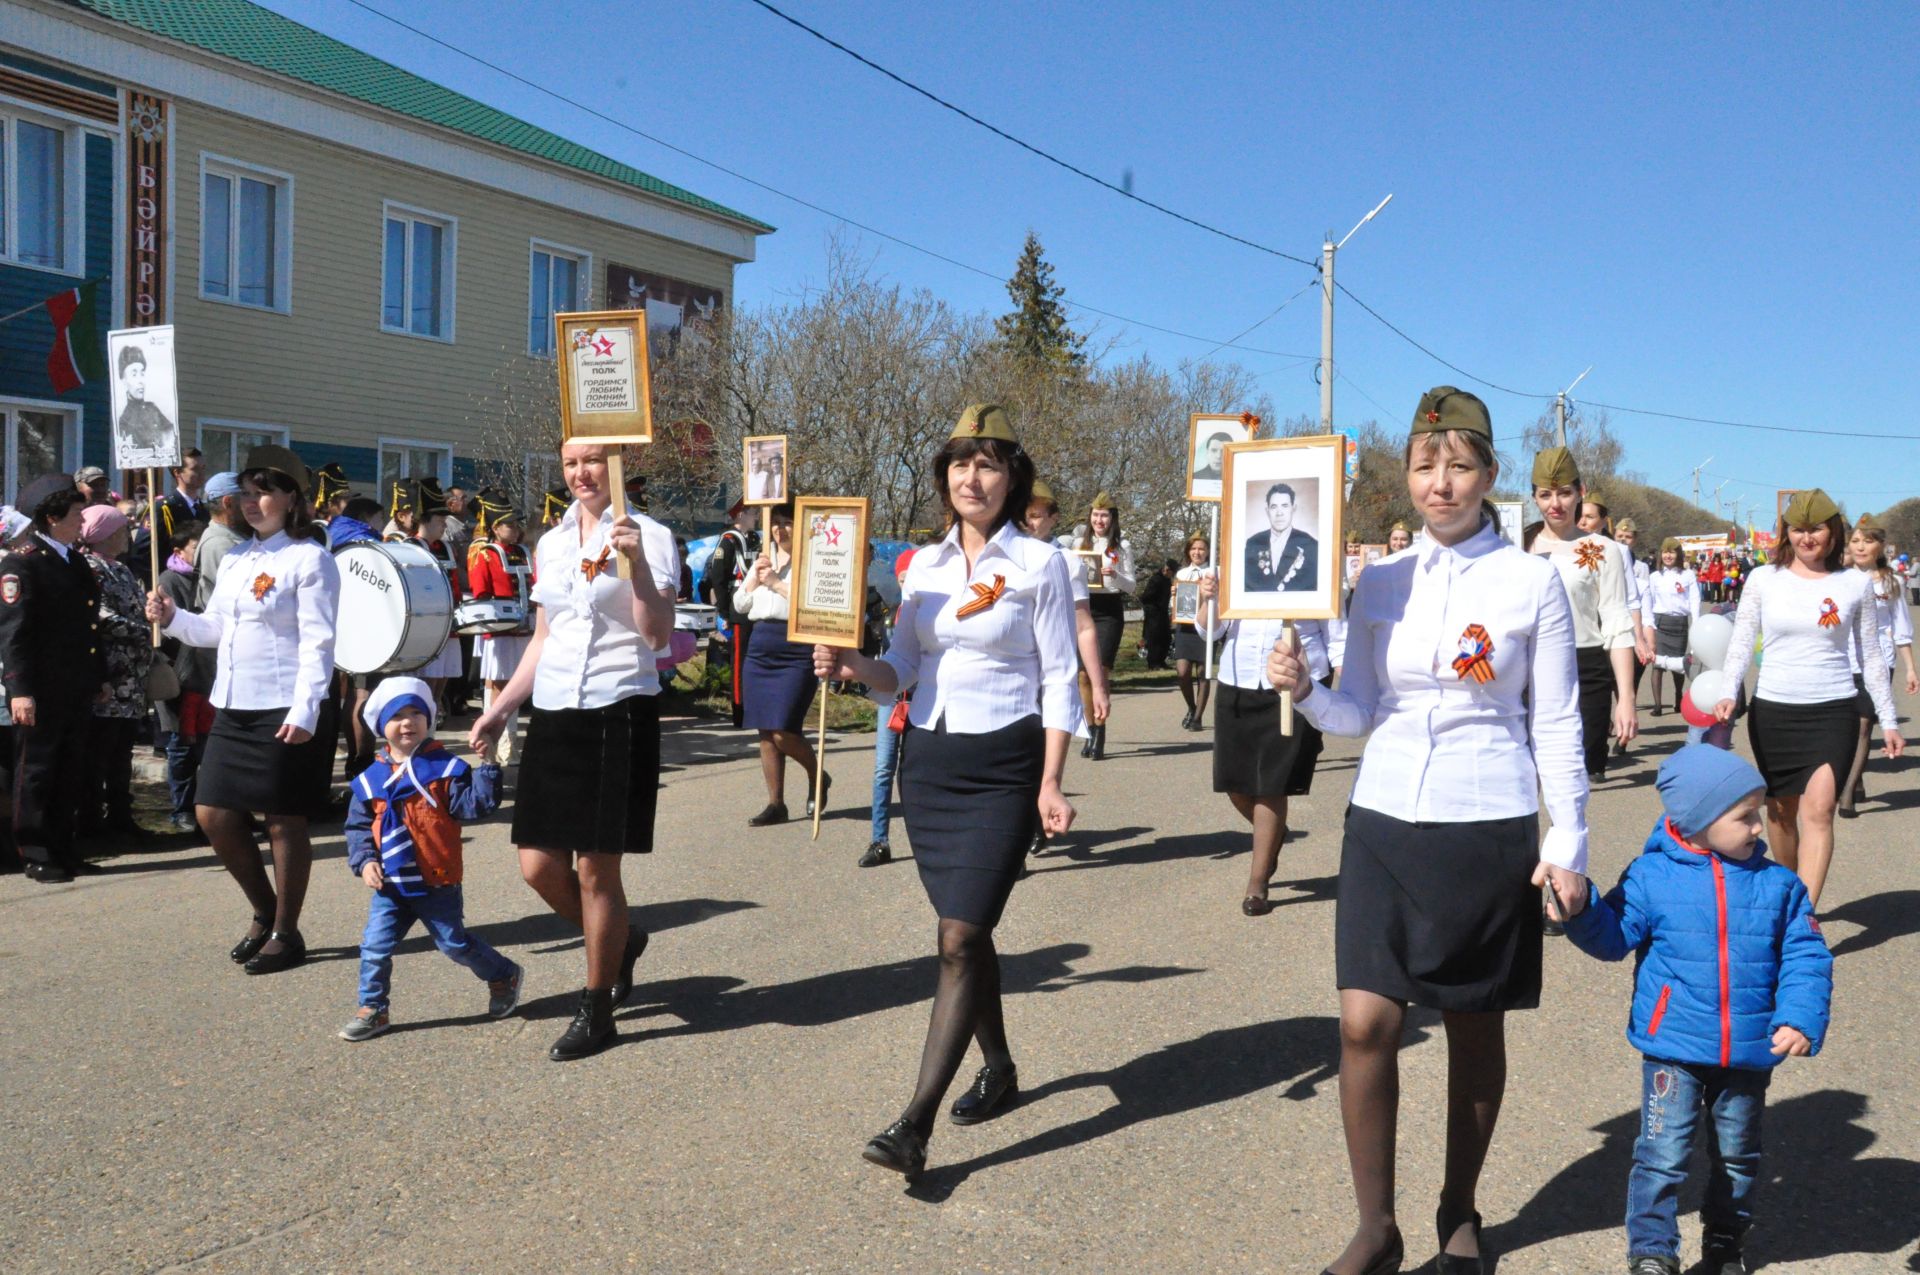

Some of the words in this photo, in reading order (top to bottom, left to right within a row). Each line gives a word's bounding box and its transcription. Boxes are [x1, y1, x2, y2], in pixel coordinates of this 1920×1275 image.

[349, 558, 393, 593] Weber
[815, 571, 846, 579] ГОРДИМСЯ
[815, 588, 845, 596] ПОМНИМ
[813, 596, 845, 604] СКОРБИМ
